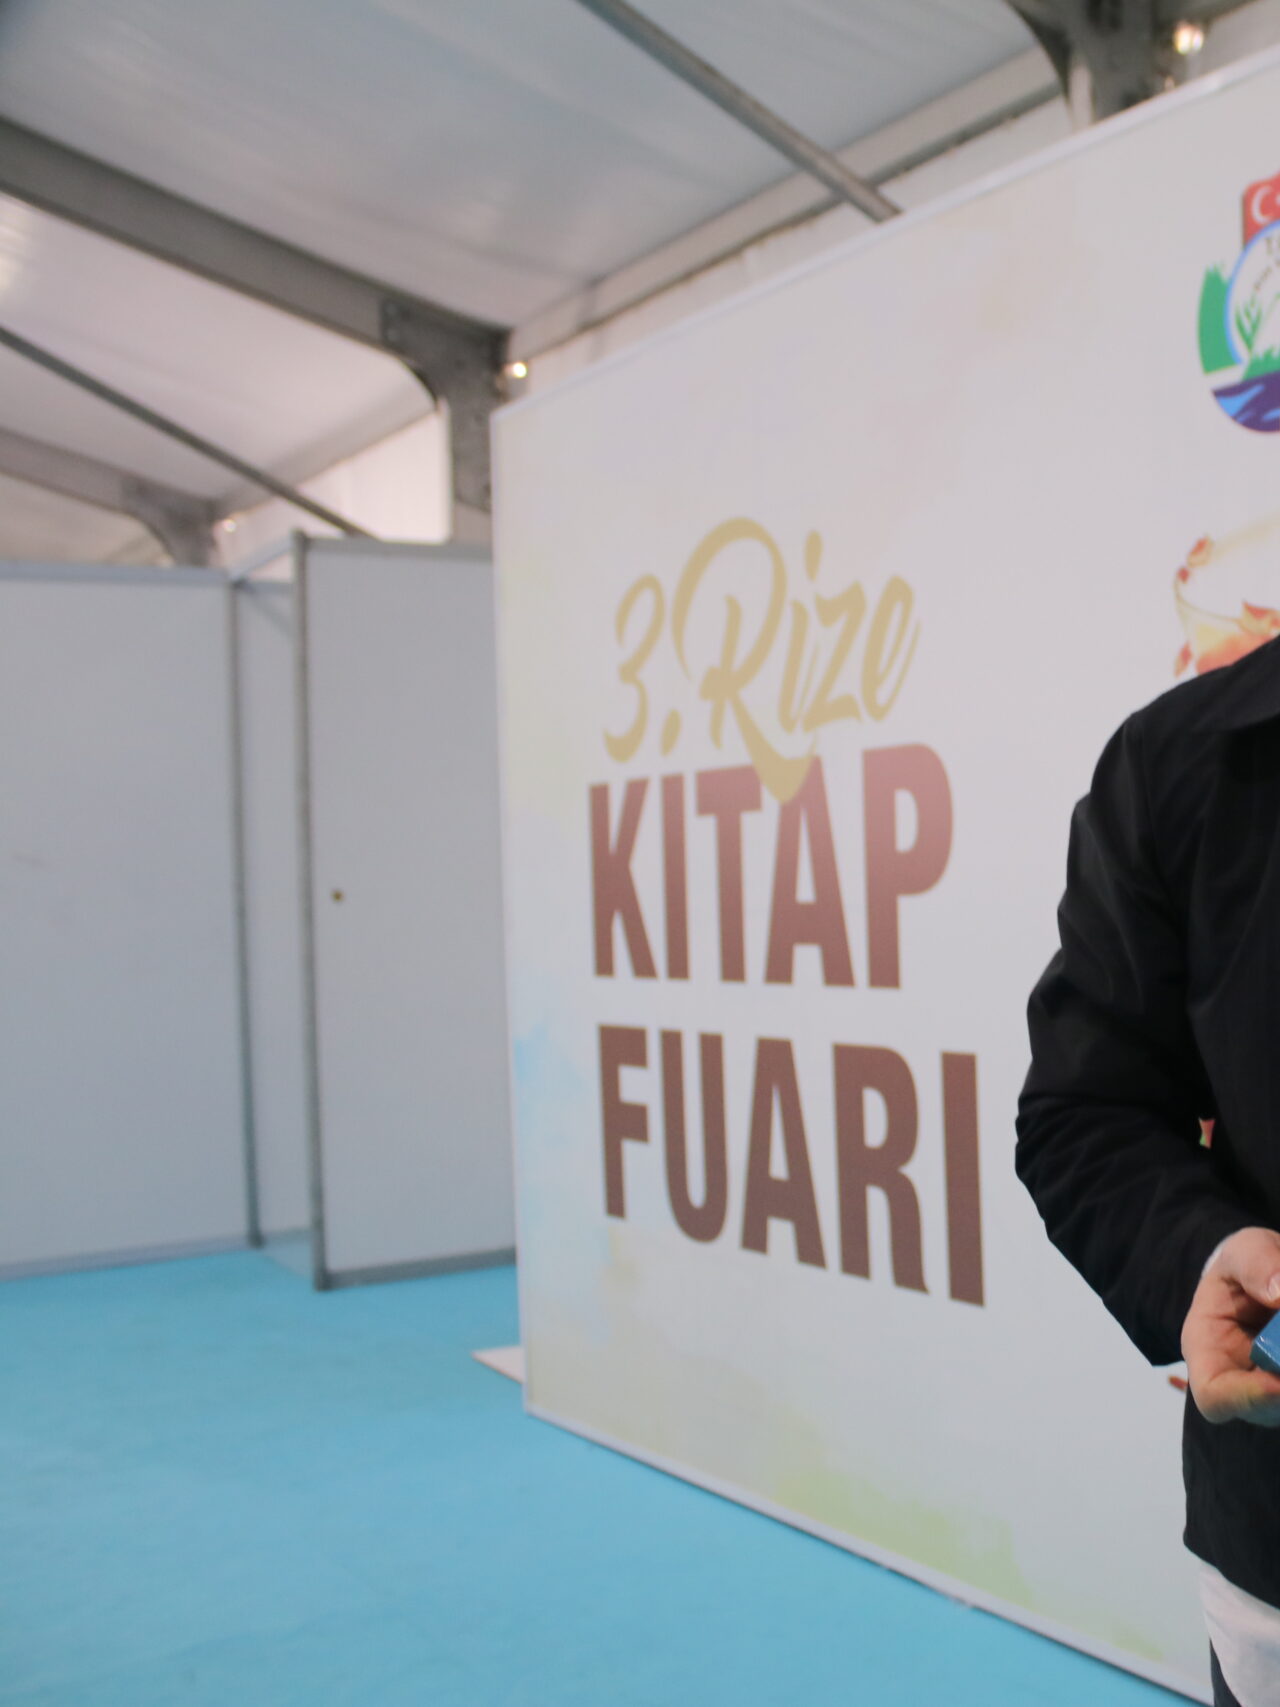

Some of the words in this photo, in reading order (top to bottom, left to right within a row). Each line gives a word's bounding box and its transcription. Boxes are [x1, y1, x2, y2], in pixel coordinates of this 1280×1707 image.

[602, 573, 682, 763] 3.
[670, 516, 921, 804] Rize
[588, 743, 954, 991] KITAP
[597, 1023, 986, 1309] FUARI
